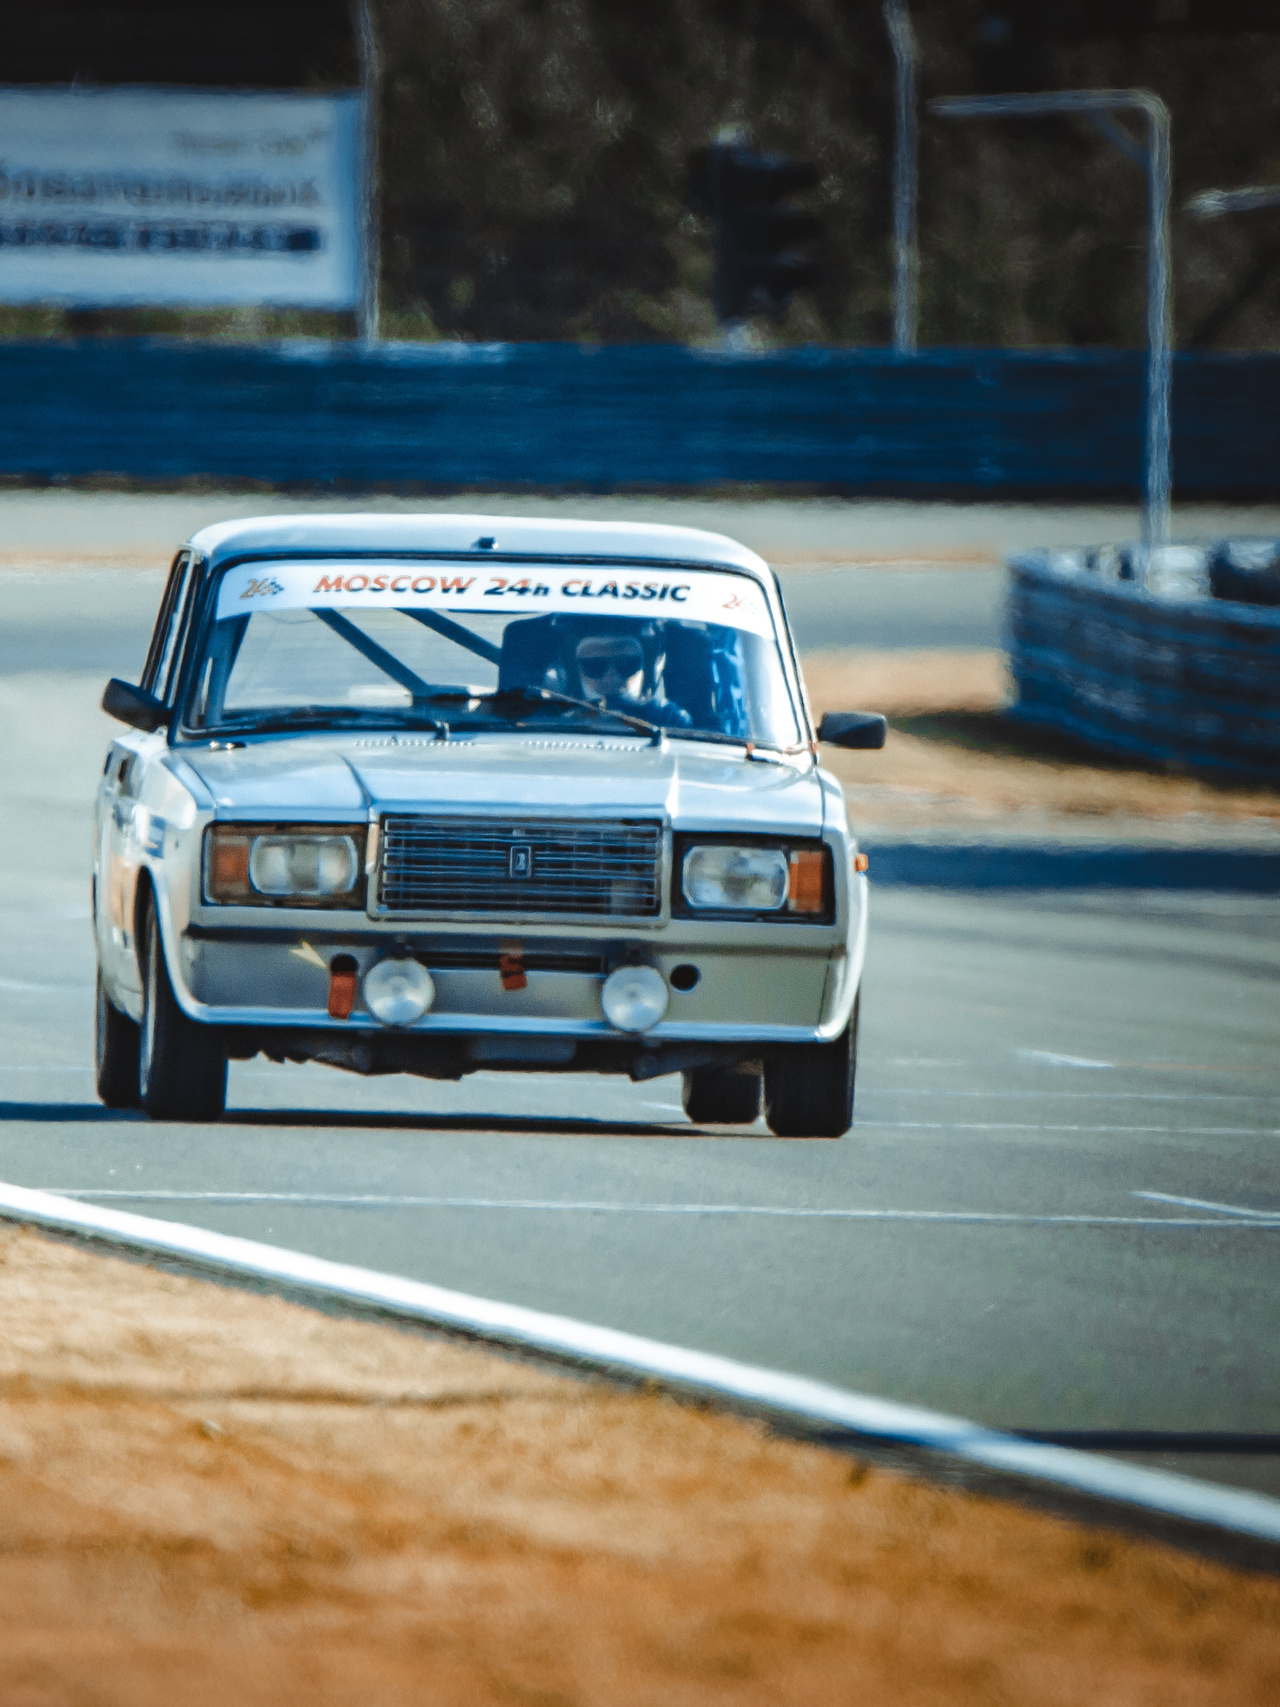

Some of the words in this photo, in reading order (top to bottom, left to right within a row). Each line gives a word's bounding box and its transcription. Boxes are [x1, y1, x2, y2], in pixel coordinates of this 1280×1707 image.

[312, 573, 476, 594] MOSCOW
[483, 576, 550, 597] 24h
[560, 578, 692, 603] CLASSIC
